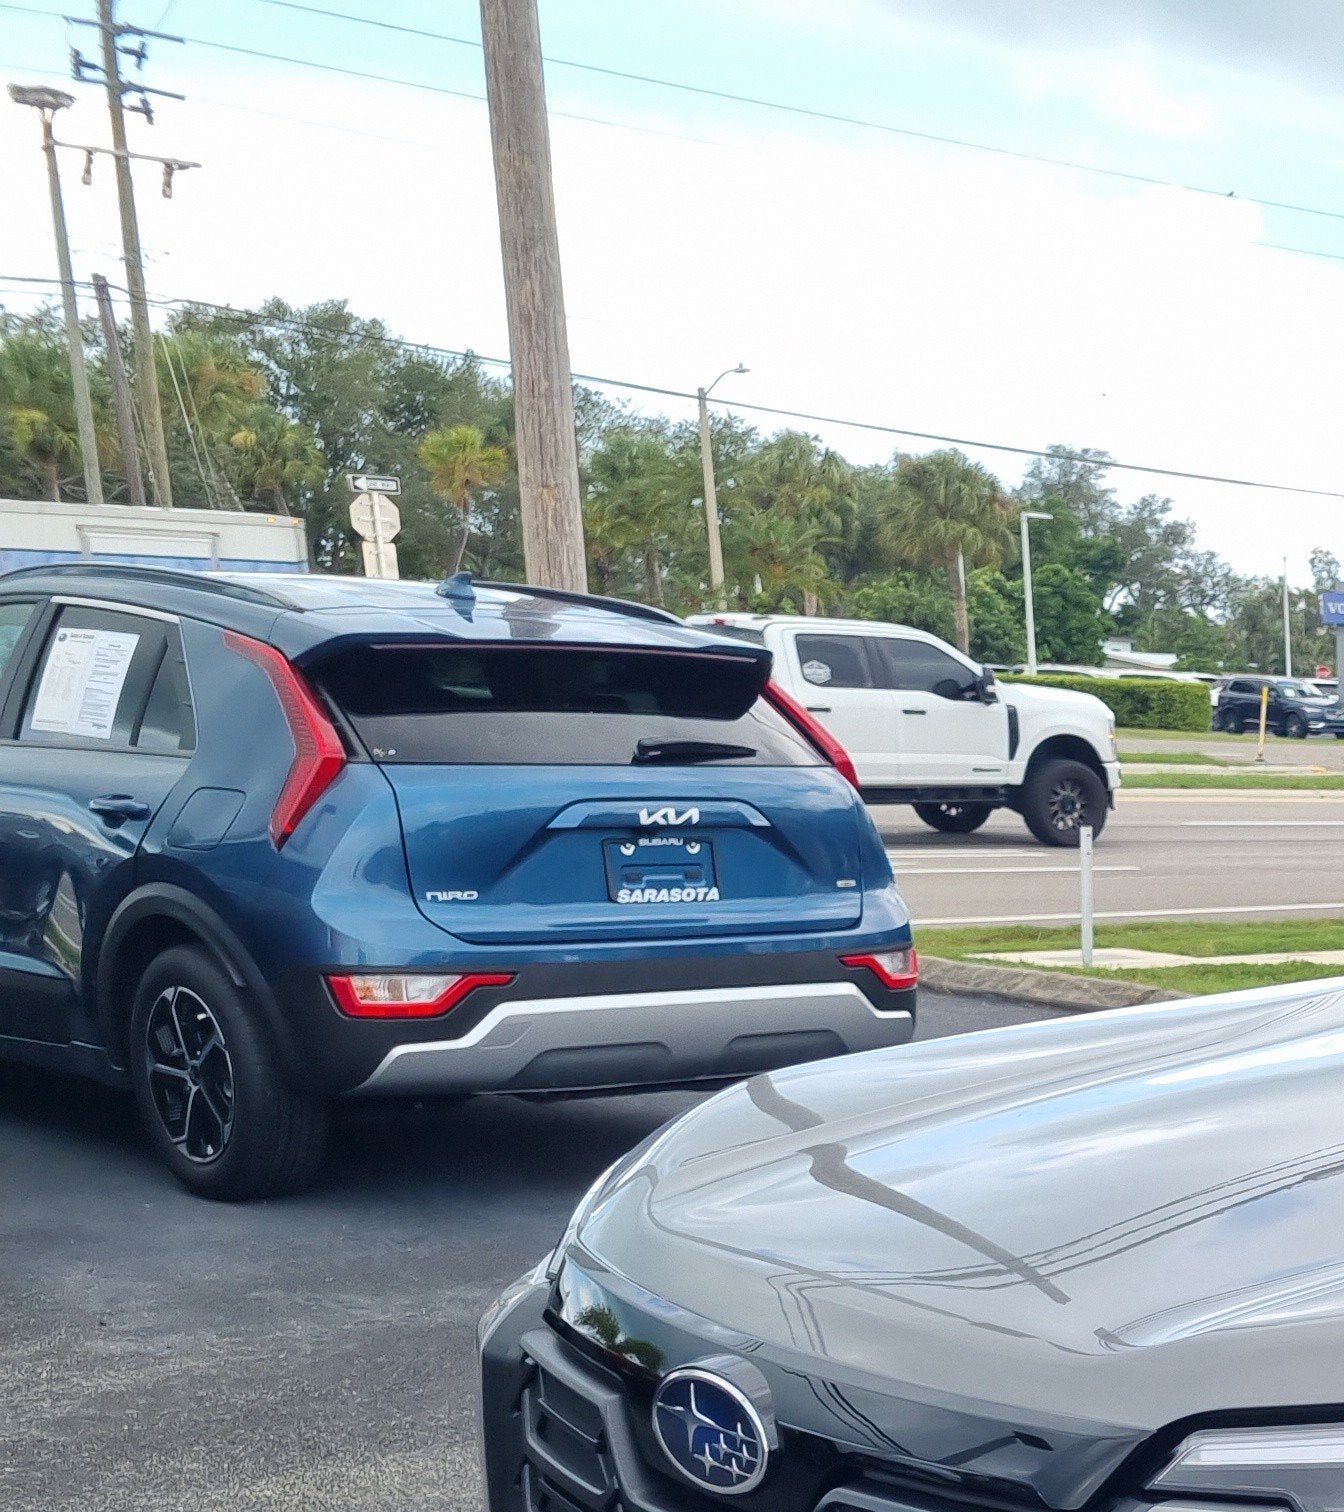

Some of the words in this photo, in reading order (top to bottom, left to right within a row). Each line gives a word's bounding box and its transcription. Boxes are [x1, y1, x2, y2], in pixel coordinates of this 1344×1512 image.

[638, 806, 700, 825] KIA
[638, 838, 684, 847] SUBARU
[617, 887, 720, 904] SARASOTA
